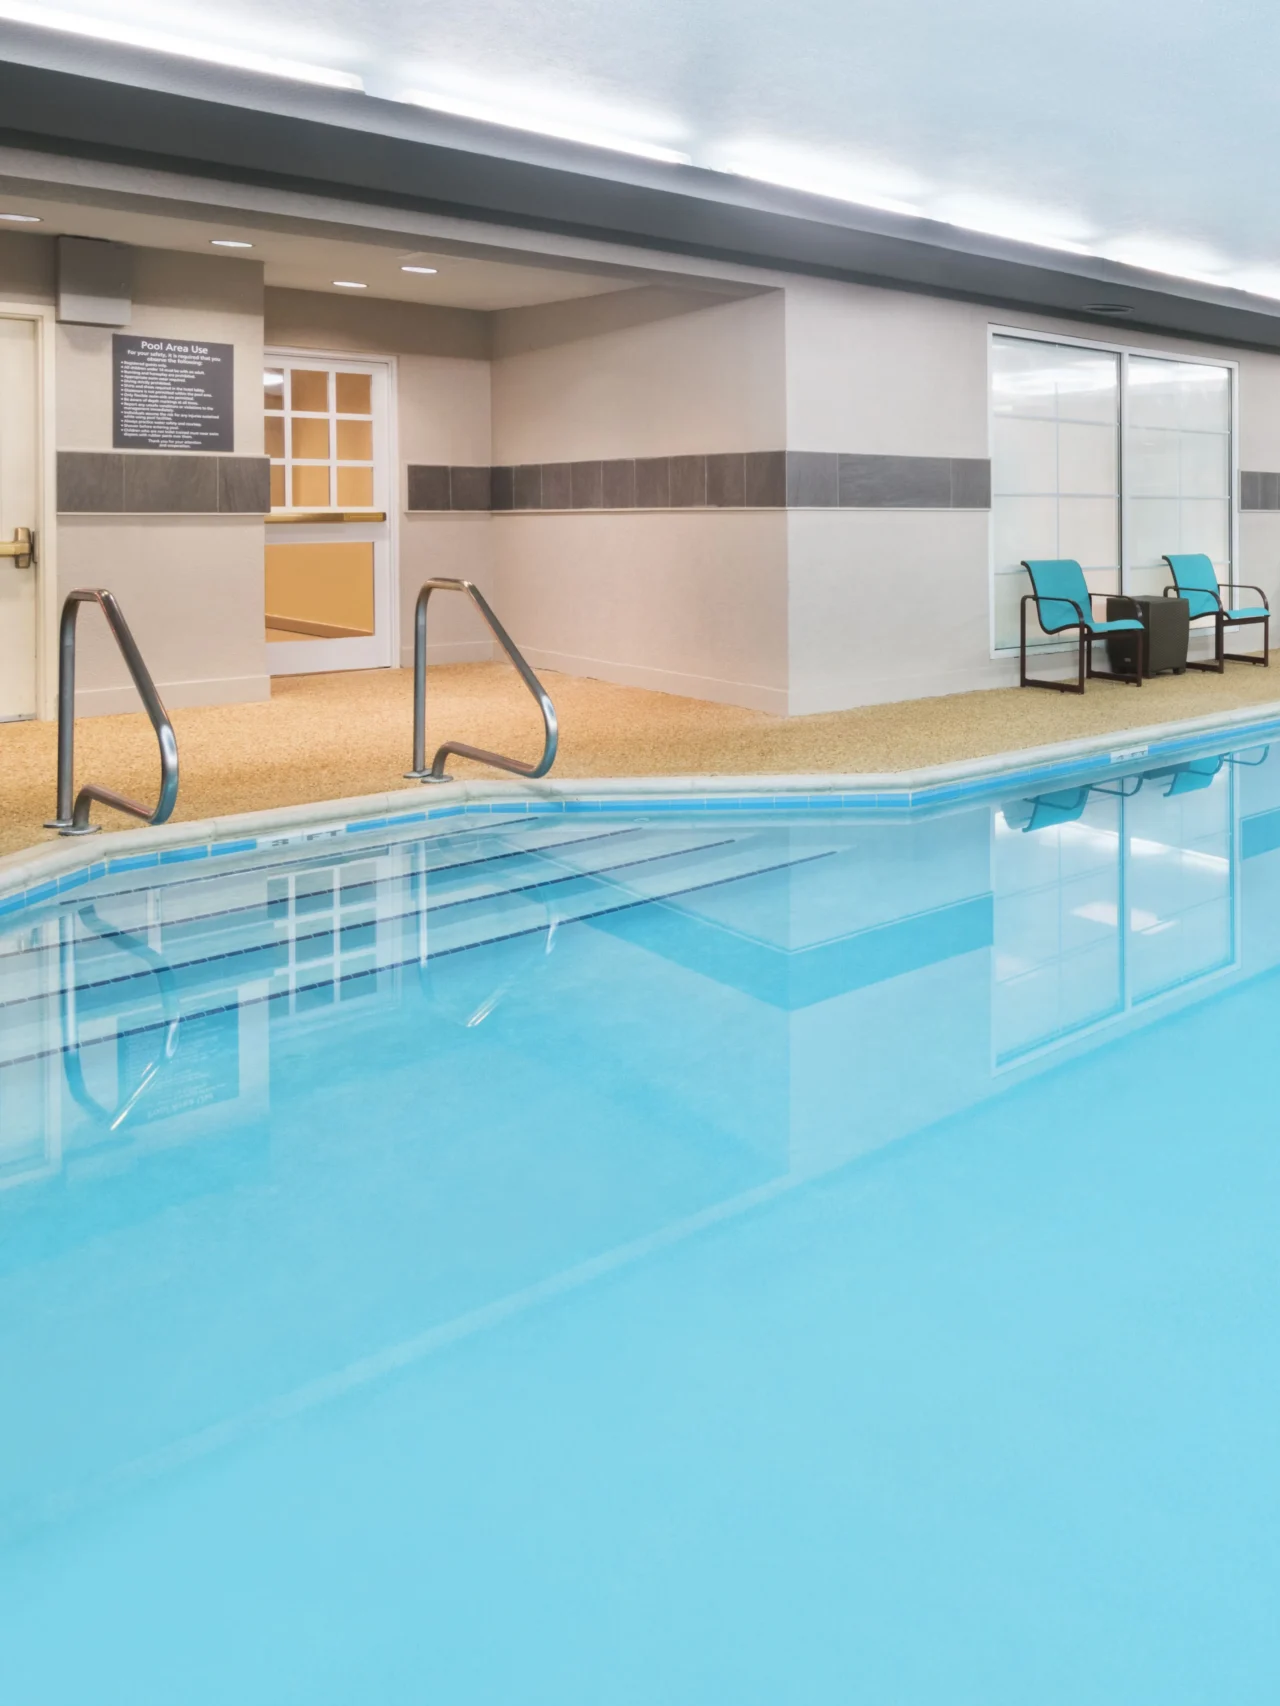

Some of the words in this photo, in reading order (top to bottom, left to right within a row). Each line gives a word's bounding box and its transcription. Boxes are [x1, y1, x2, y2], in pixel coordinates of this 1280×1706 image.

[142, 341, 163, 351] Pool
[166, 343, 188, 353] Area
[192, 345, 208, 354] Use
[271, 838, 289, 847] 3
[306, 829, 343, 841] FT
